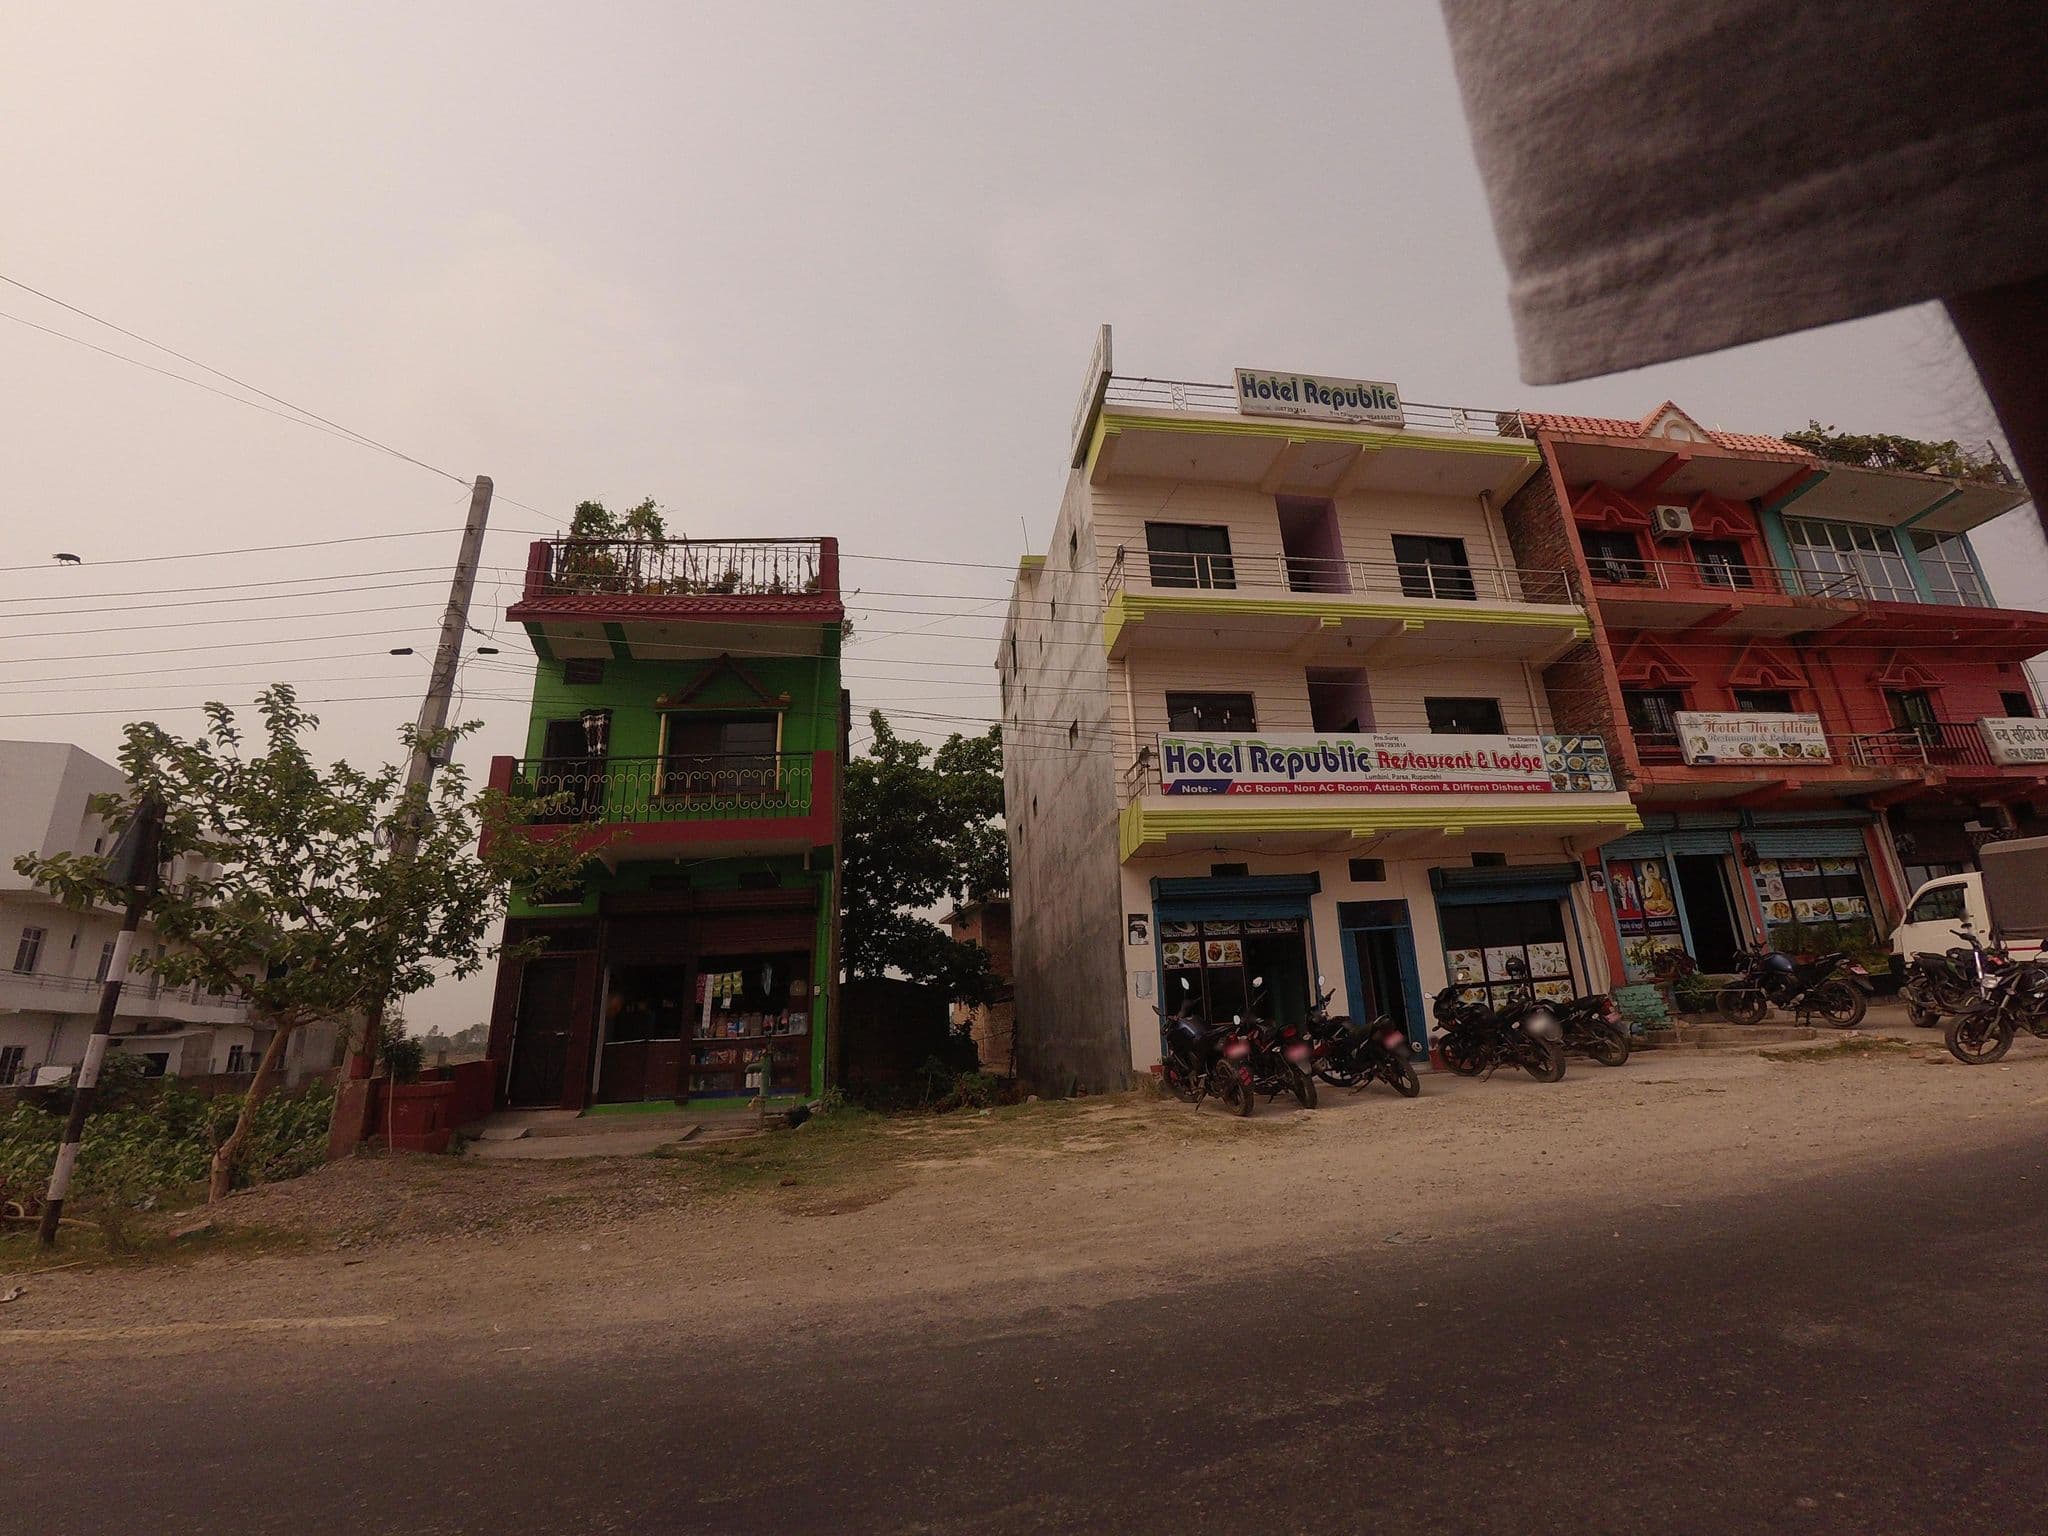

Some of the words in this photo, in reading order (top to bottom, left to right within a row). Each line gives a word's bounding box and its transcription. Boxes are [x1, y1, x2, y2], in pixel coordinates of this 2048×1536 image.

[1240, 374, 1299, 402] Hotel
[1303, 378, 1398, 411] Republic
[1703, 721, 1741, 734] Hotel
[1164, 742, 1242, 773] Hotel
[1248, 743, 1371, 780] Republic
[1477, 751, 1488, 769] &
[1181, 784, 1217, 793] Note:-
[1235, 784, 1252, 793] AC
[1255, 784, 1292, 794] Room,
[1294, 784, 1316, 793] Non
[1318, 784, 1335, 792] AC
[1337, 784, 1372, 794] Room,
[1374, 783, 1408, 792] Attach
[1410, 783, 1440, 792] Room
[1442, 784, 1450, 792] &
[1452, 783, 1490, 792] Diffrent
[1492, 783, 1525, 792] Dishes
[1527, 783, 1544, 792] etc.
